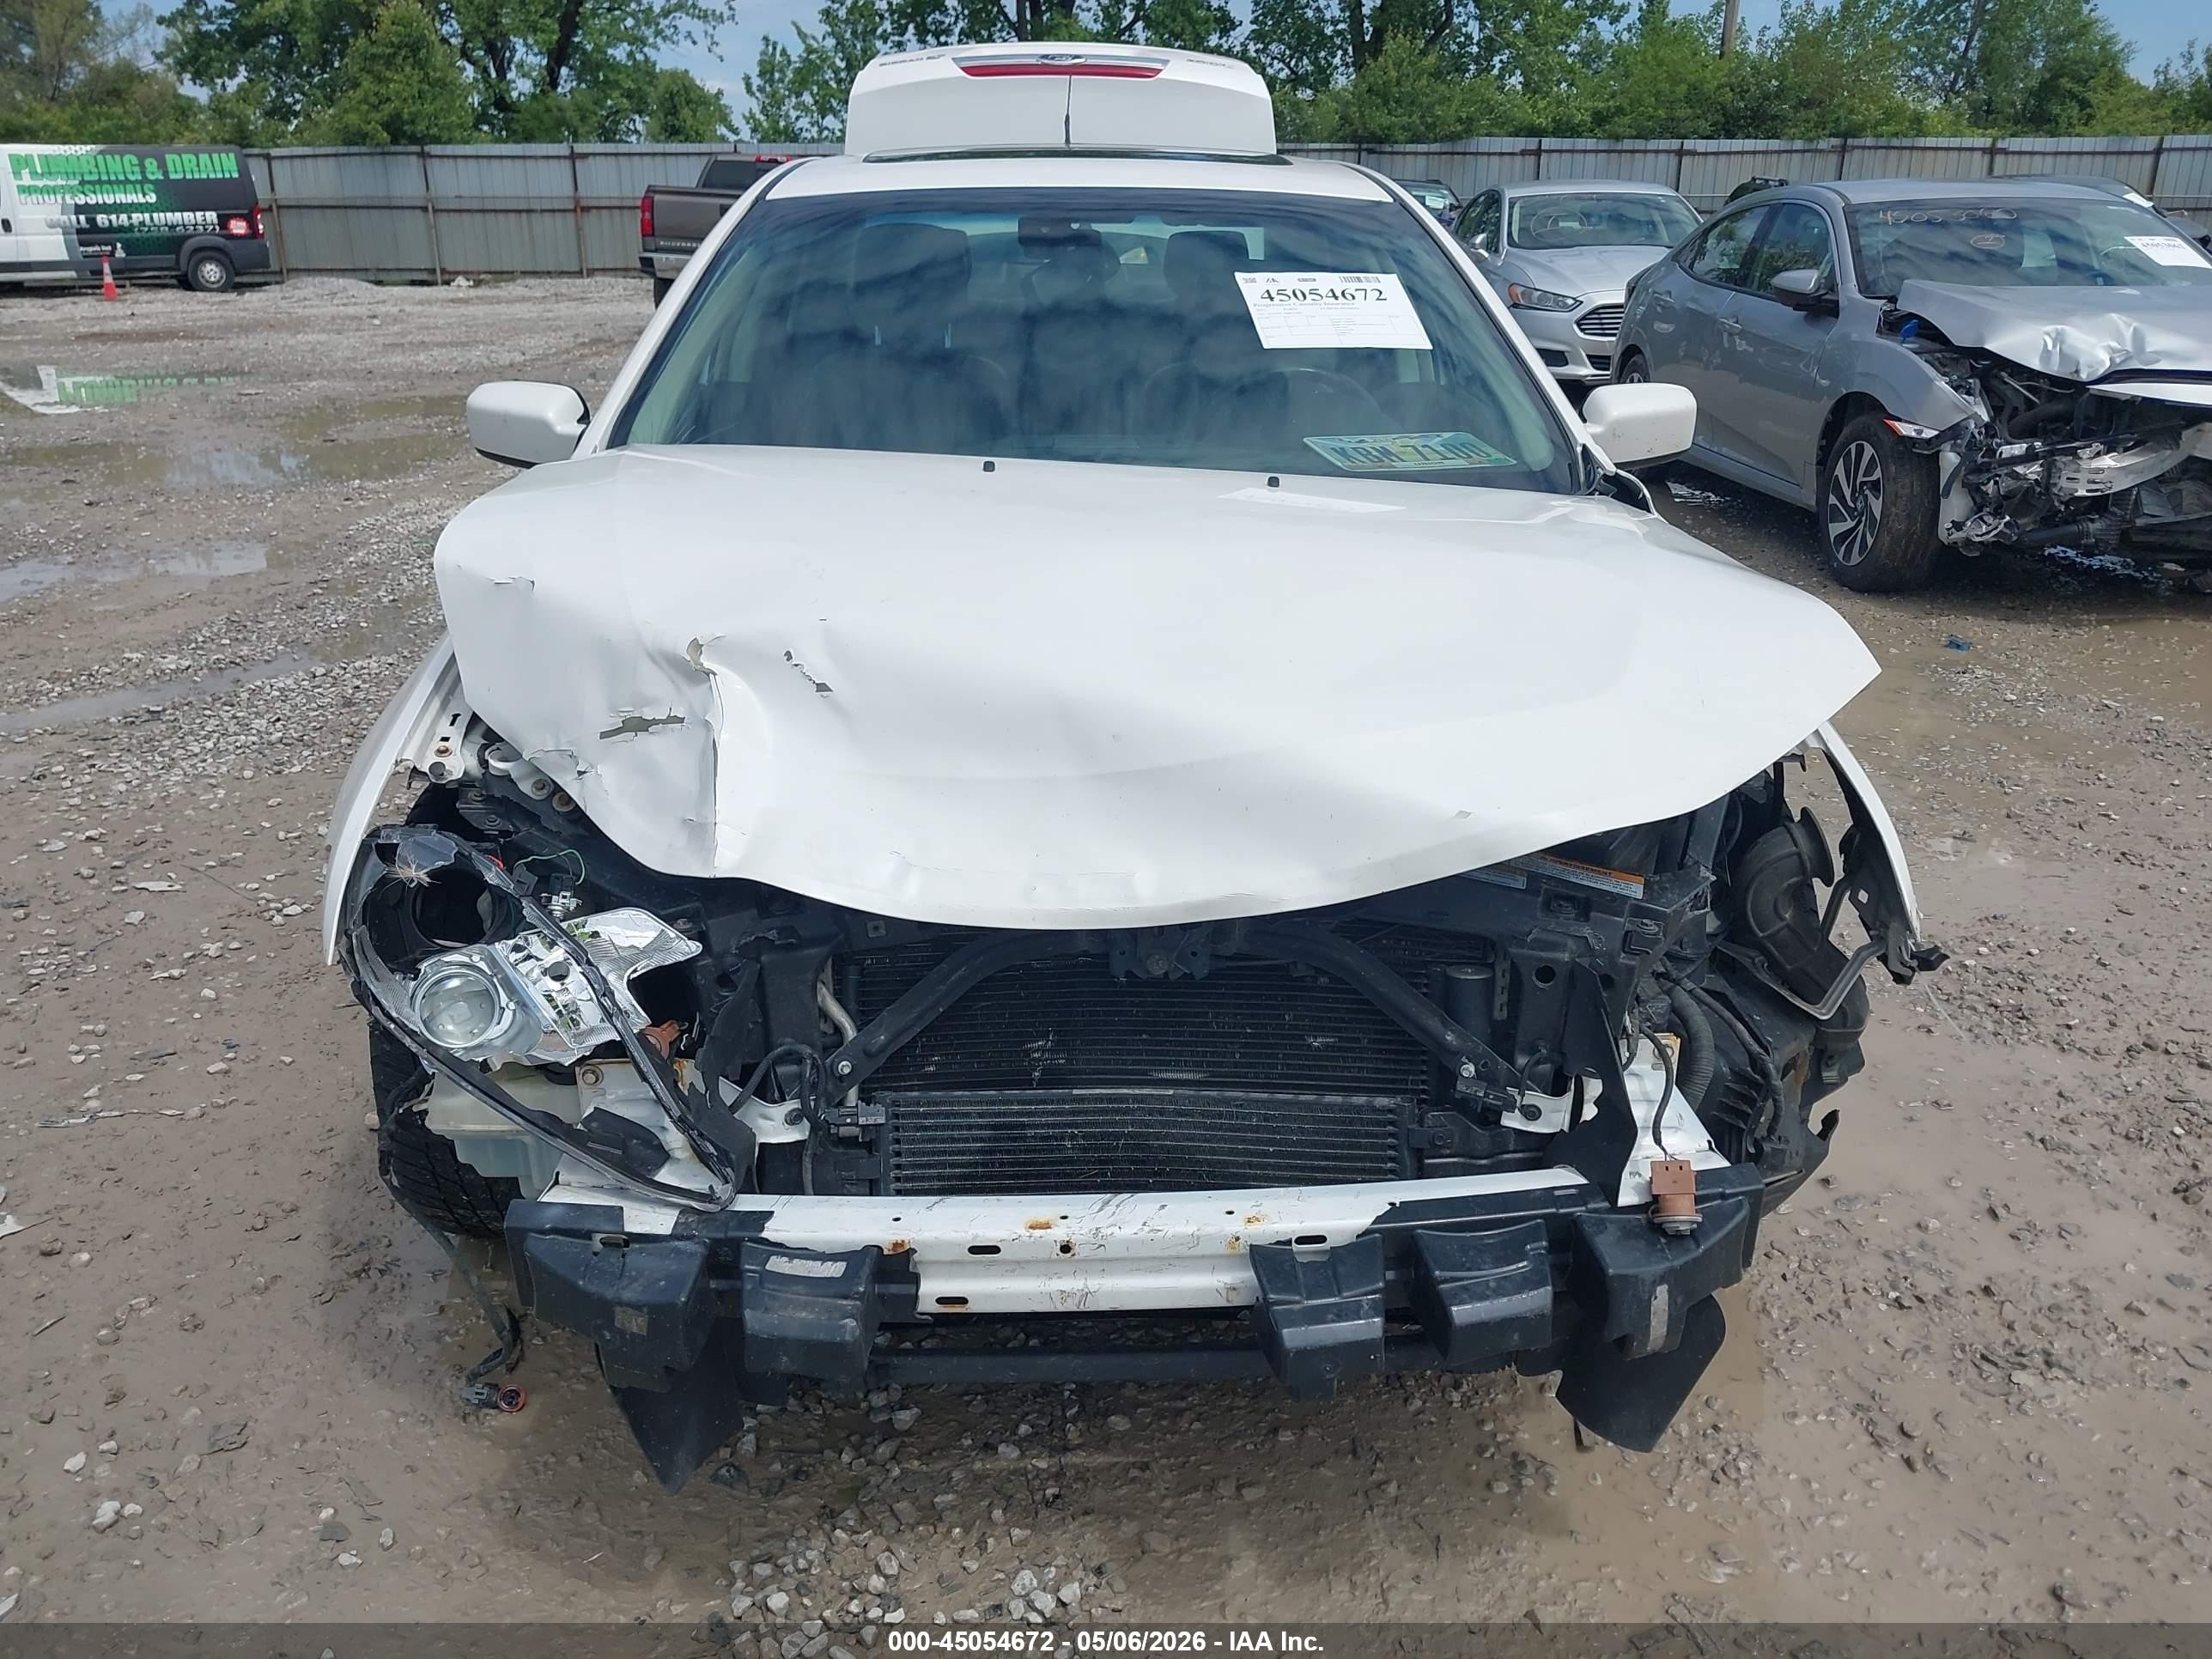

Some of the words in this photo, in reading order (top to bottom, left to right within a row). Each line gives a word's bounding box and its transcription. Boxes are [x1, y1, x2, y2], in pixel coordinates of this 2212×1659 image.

[9, 153, 142, 181] PLUMBING
[144, 157, 164, 180] &
[165, 152, 239, 179] DRAIN
[17, 184, 156, 205] PROFESSIONALS
[46, 214, 89, 228] CALL
[96, 211, 219, 228] 614-PLUMBER
[1261, 289, 1388, 302] 45054672
[1399, 441, 1492, 462] 7100
